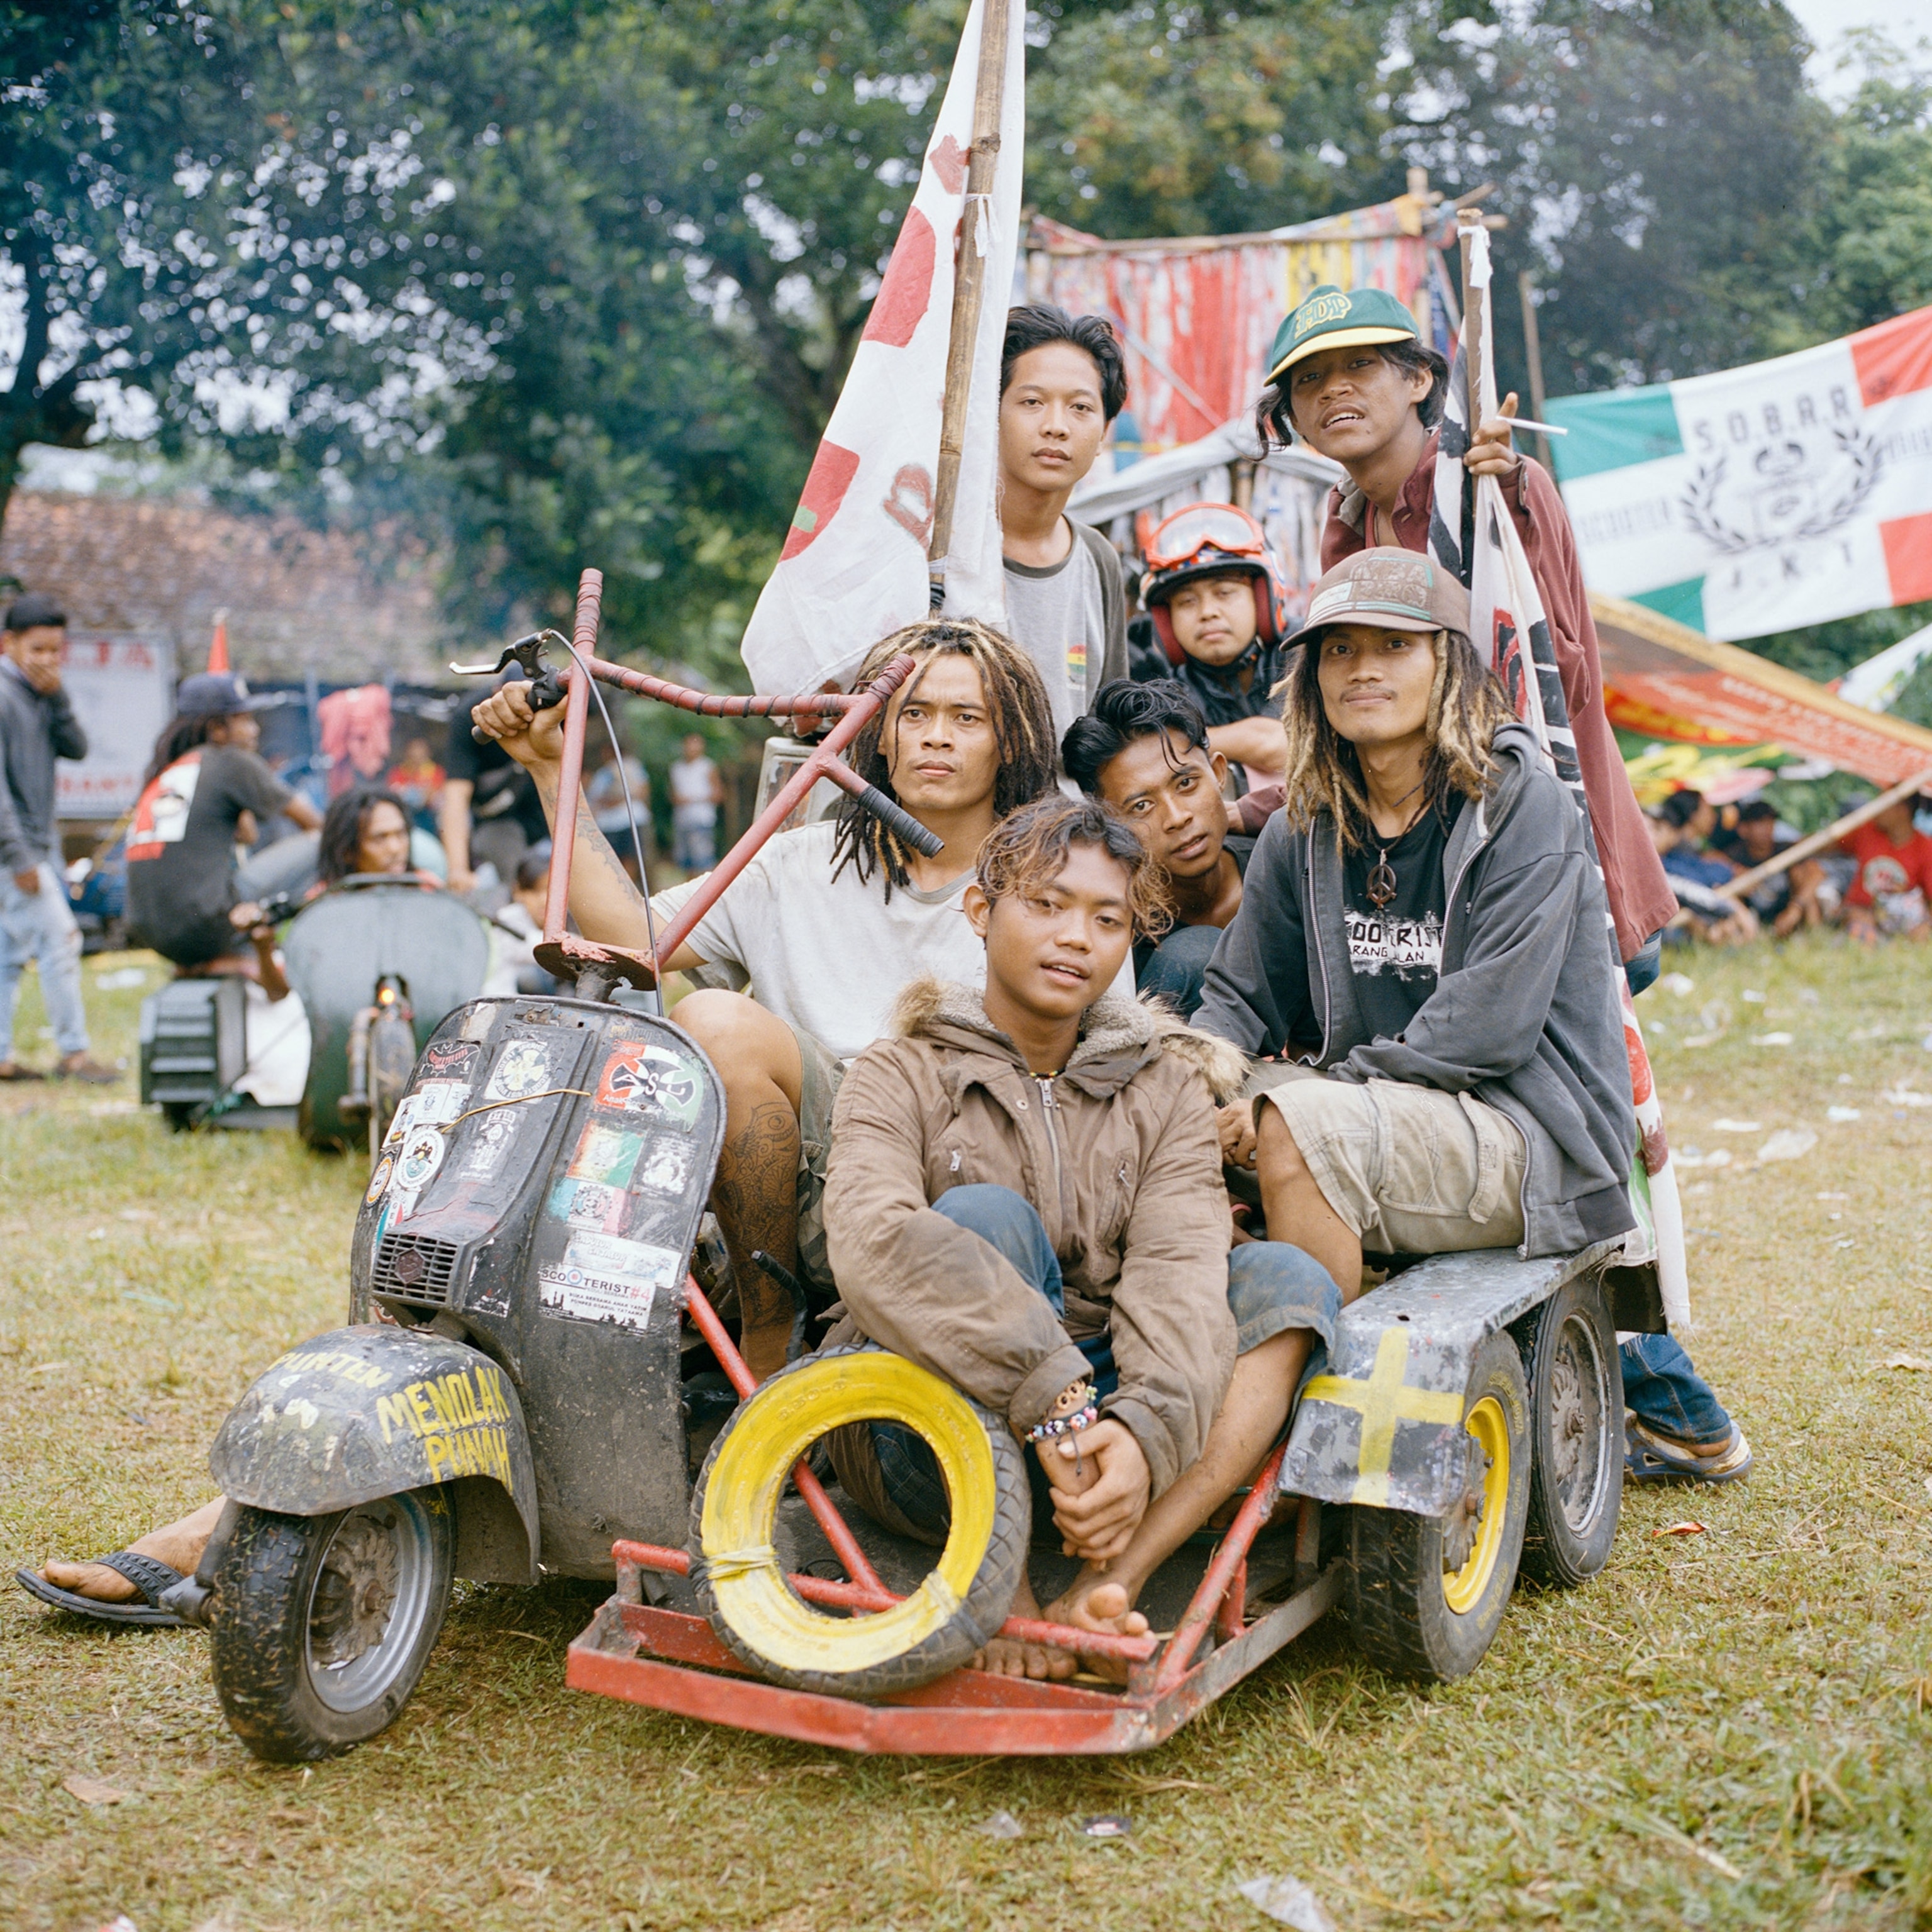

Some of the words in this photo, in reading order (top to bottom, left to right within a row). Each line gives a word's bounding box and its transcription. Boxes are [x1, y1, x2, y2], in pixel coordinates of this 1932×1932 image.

[631, 1285, 651, 1302] #4
[266, 1348, 393, 1389] PUNTEN
[377, 1365, 511, 1445] MENOLAK
[425, 1426, 513, 1496] PUNAH
